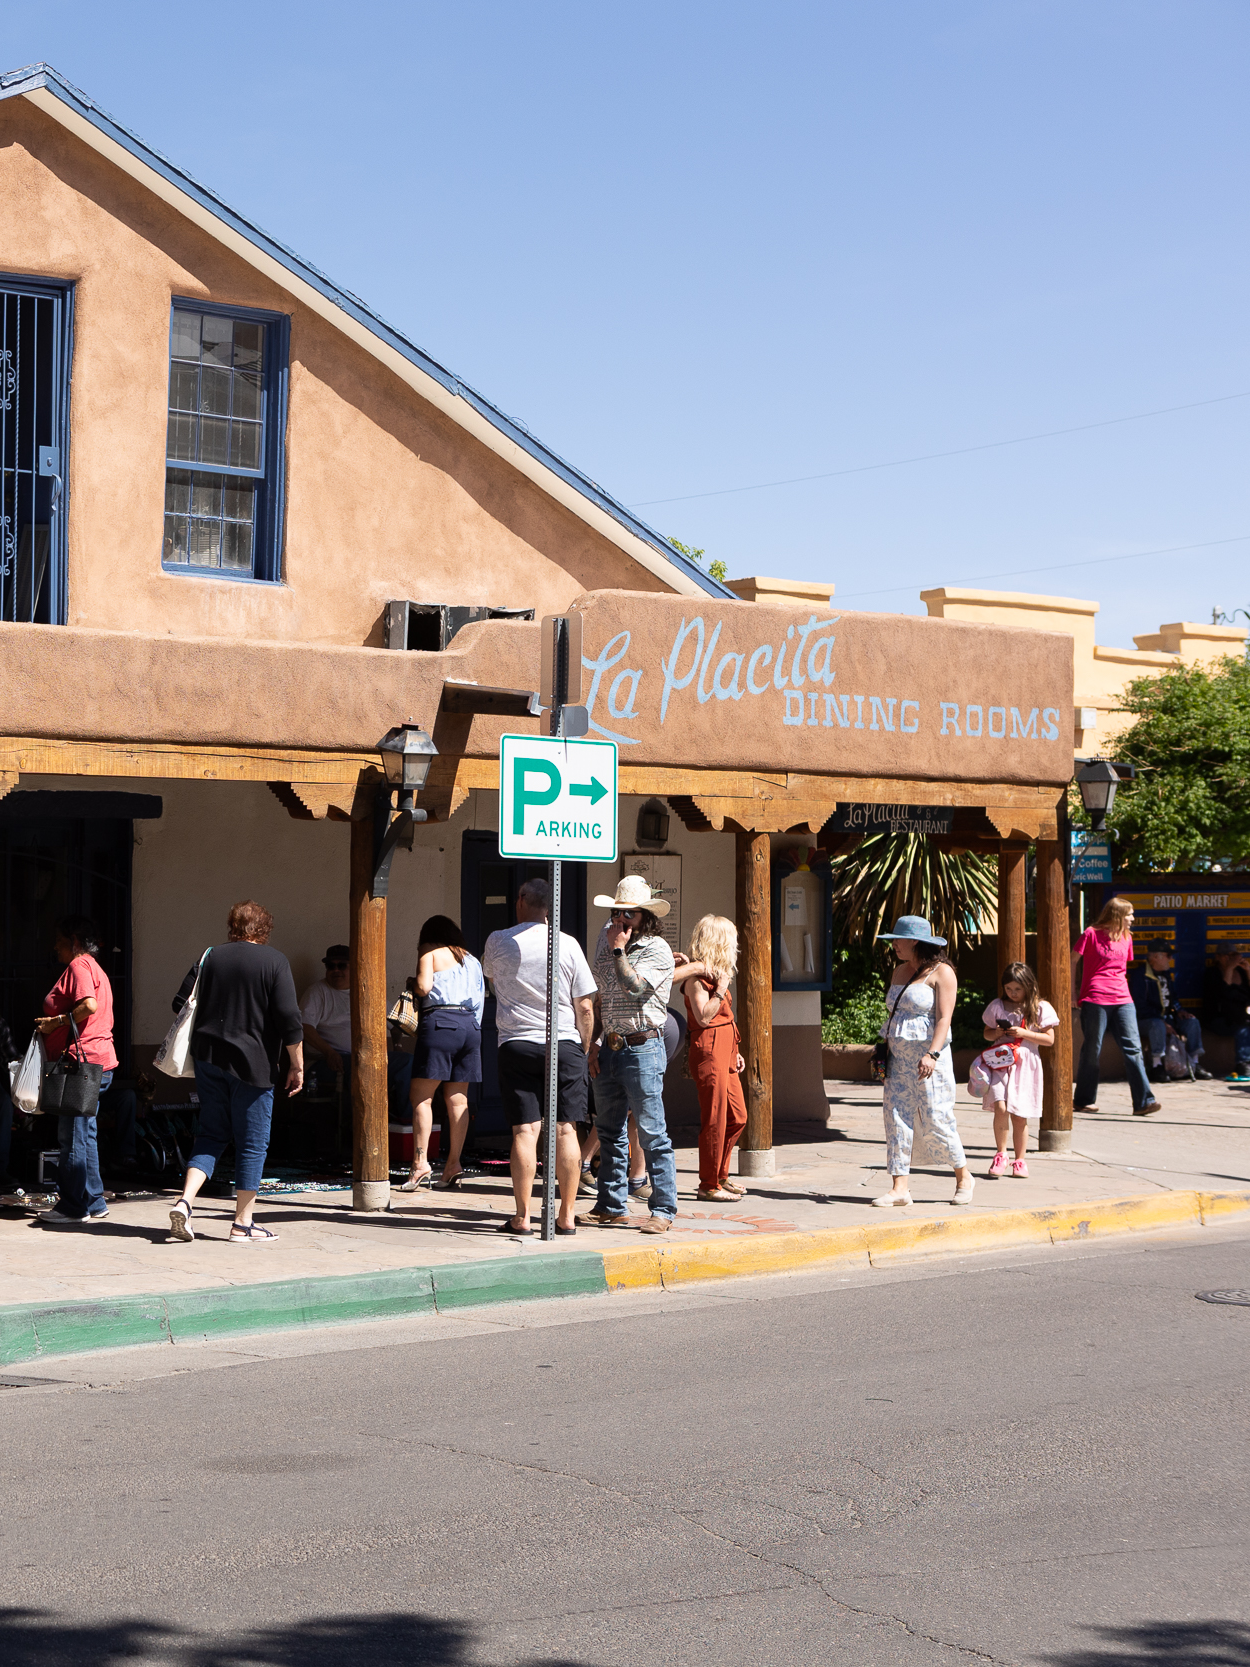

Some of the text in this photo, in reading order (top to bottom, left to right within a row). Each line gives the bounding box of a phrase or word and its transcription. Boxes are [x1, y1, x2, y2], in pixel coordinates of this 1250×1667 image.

[581, 614, 842, 745] La Placita
[782, 689, 1061, 742] DINING ROOMS
[890, 818, 949, 834] RESTAURANT
[1078, 858, 1109, 868] Coffee
[1086, 872, 1104, 881] Well
[1153, 894, 1230, 908] PATIO MARKET
